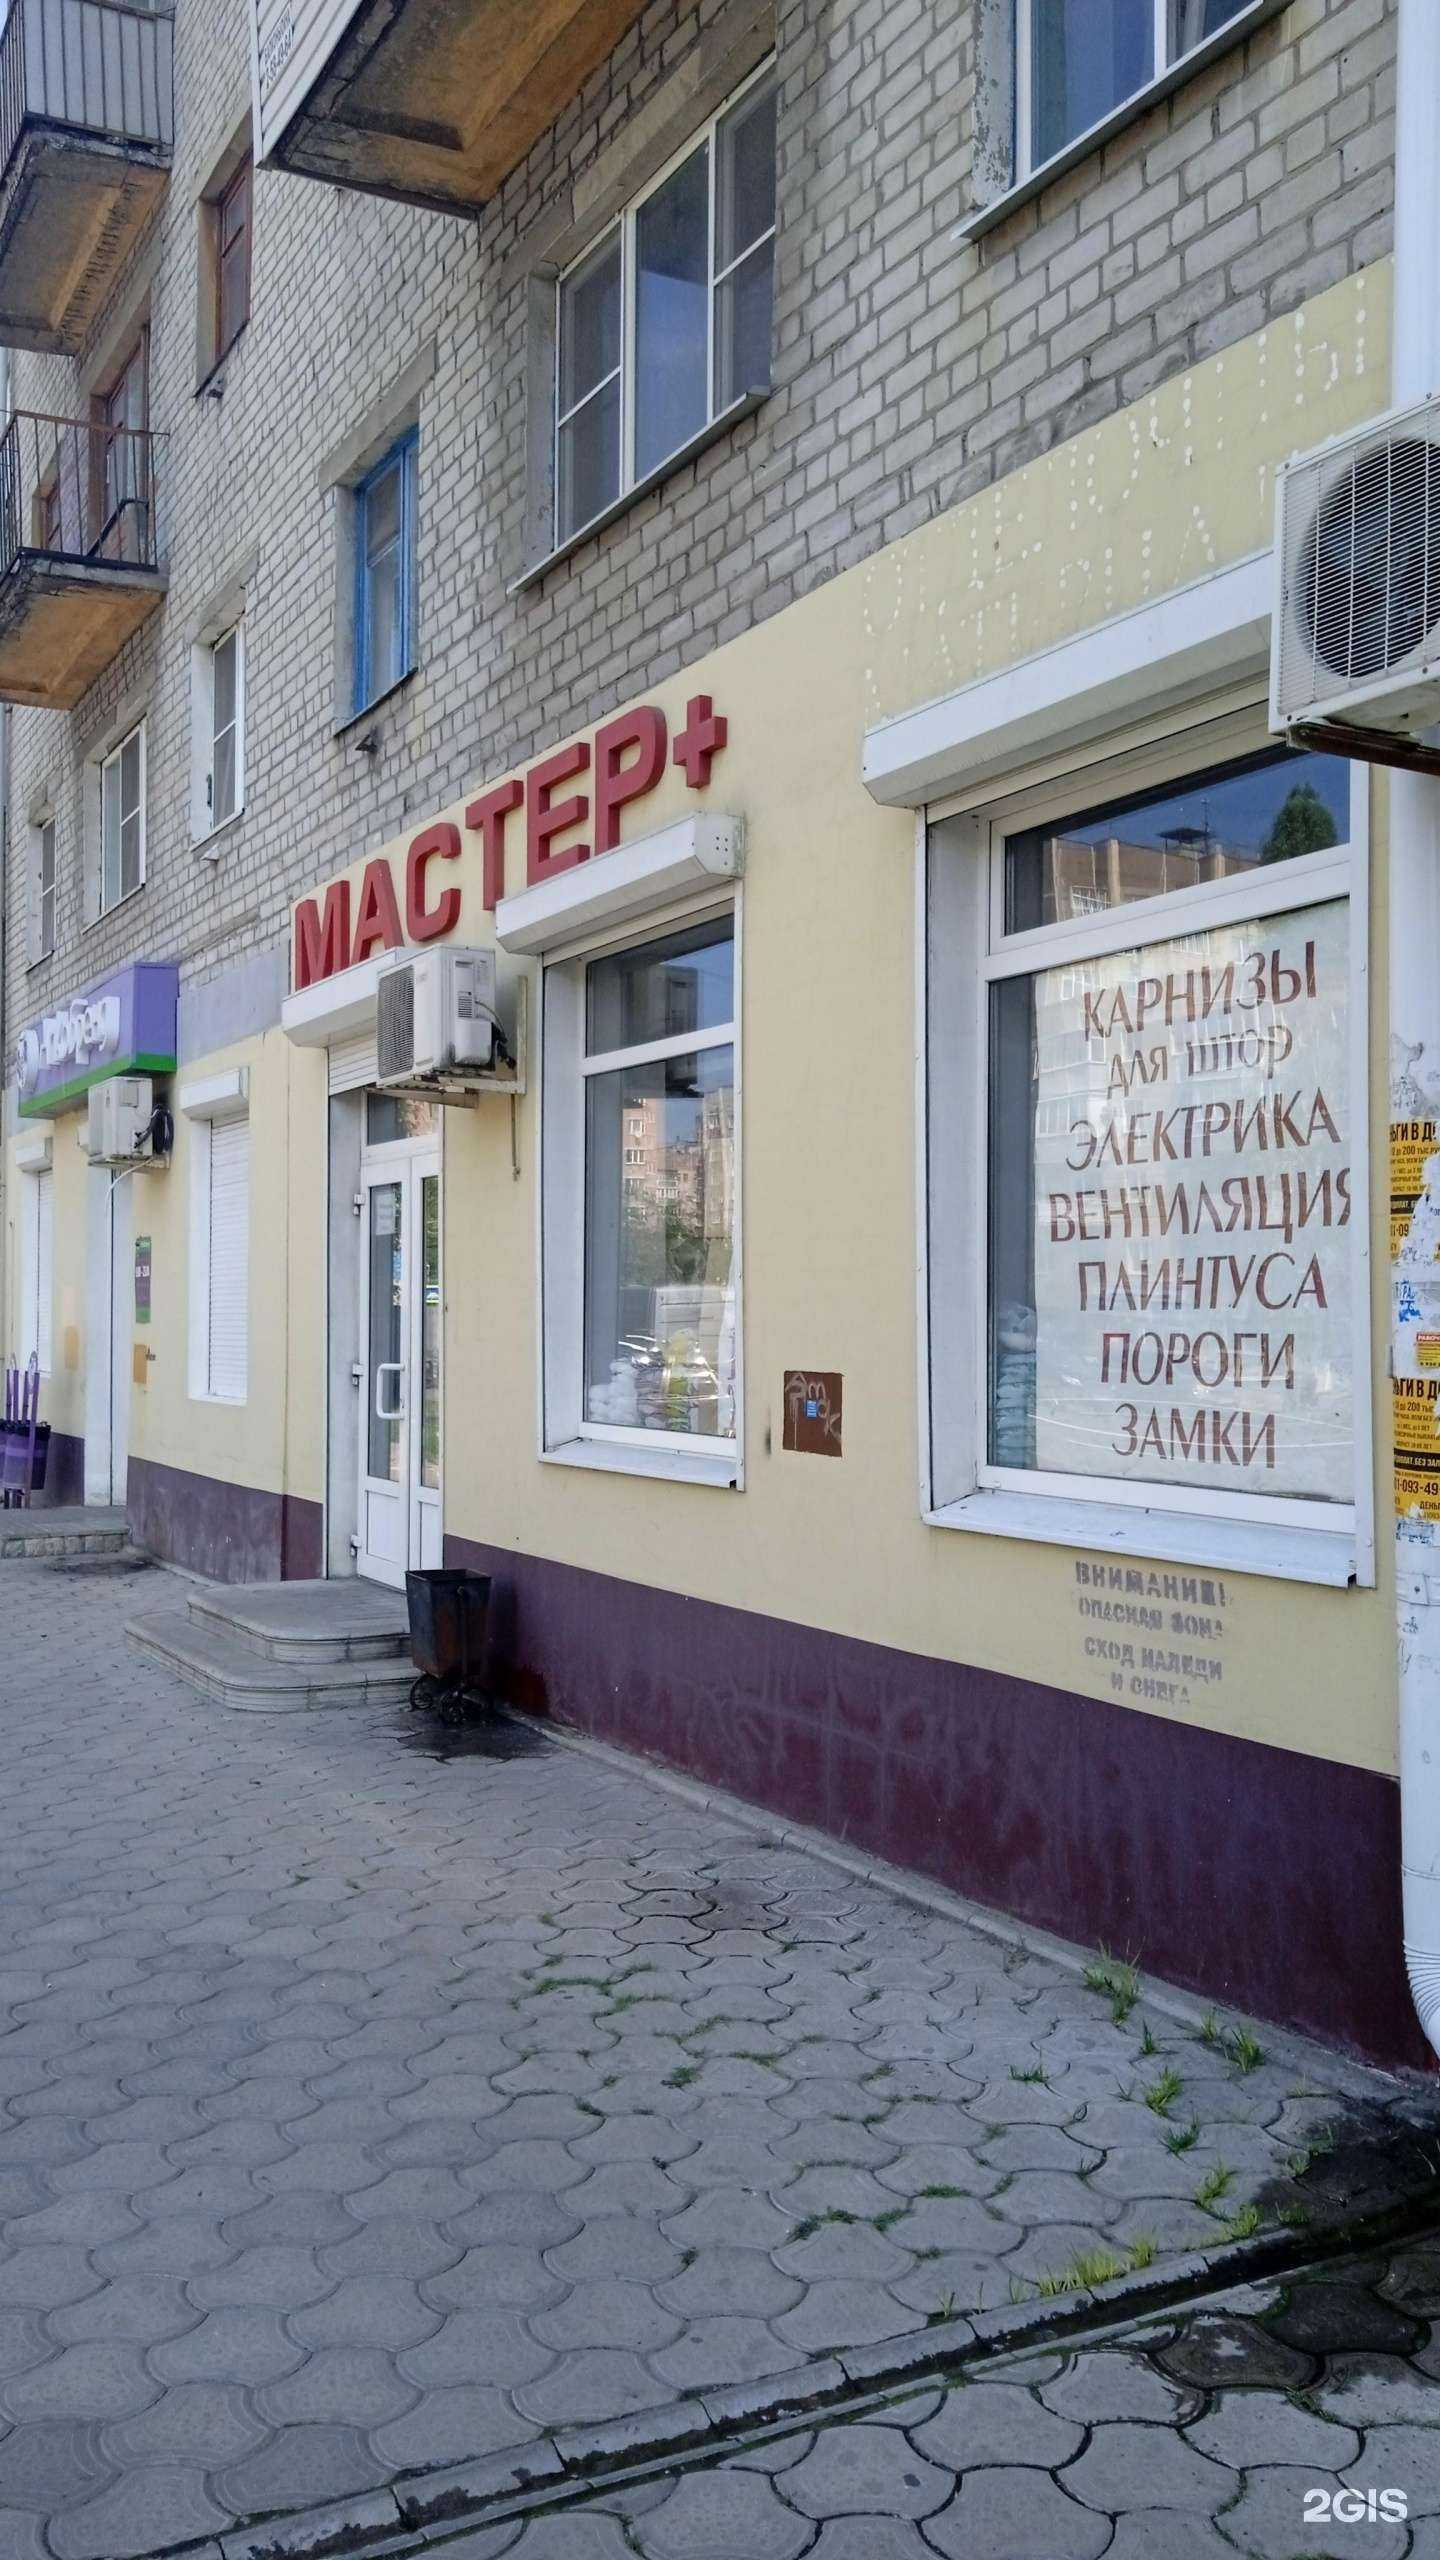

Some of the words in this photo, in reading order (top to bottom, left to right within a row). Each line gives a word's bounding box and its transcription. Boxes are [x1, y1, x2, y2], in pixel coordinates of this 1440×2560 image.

[295, 694, 728, 992] МАСТЕР+
[1083, 941, 1317, 1042] КАРНИЗЫ
[1107, 1046, 1169, 1099] ДЛЯ
[1187, 1024, 1293, 1081] ШТОР
[1066, 1087, 1342, 1171] ЭЛЕКТРИКА
[1078, 1252, 1328, 1312] ПЛИНТУСА
[1100, 1332, 1295, 1390] ПОРОГИ
[1111, 1401, 1276, 1470] ЗАМКИ
